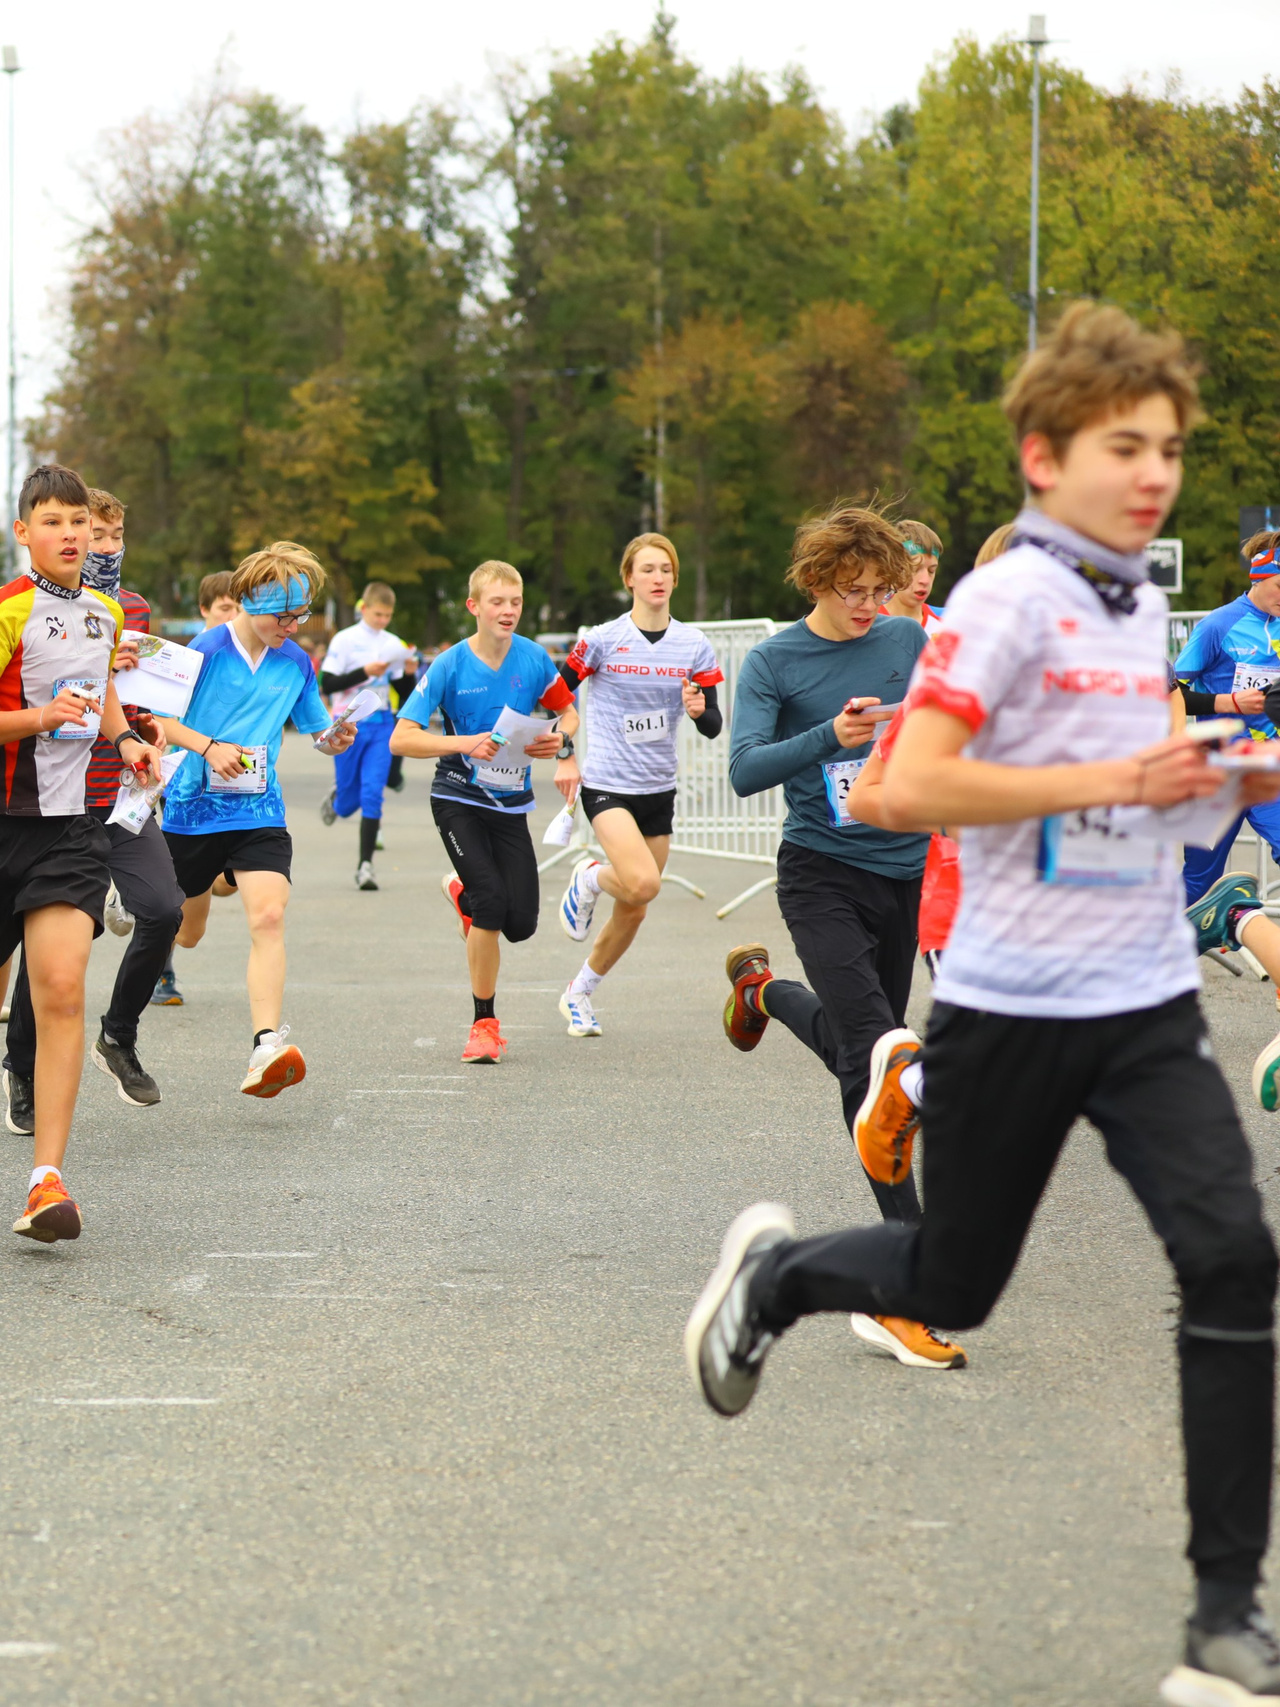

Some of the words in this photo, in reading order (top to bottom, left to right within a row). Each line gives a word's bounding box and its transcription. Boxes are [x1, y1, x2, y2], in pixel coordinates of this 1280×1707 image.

[606, 664, 650, 676] NORD
[655, 666, 693, 678] WEST
[625, 714, 665, 734] 361.1
